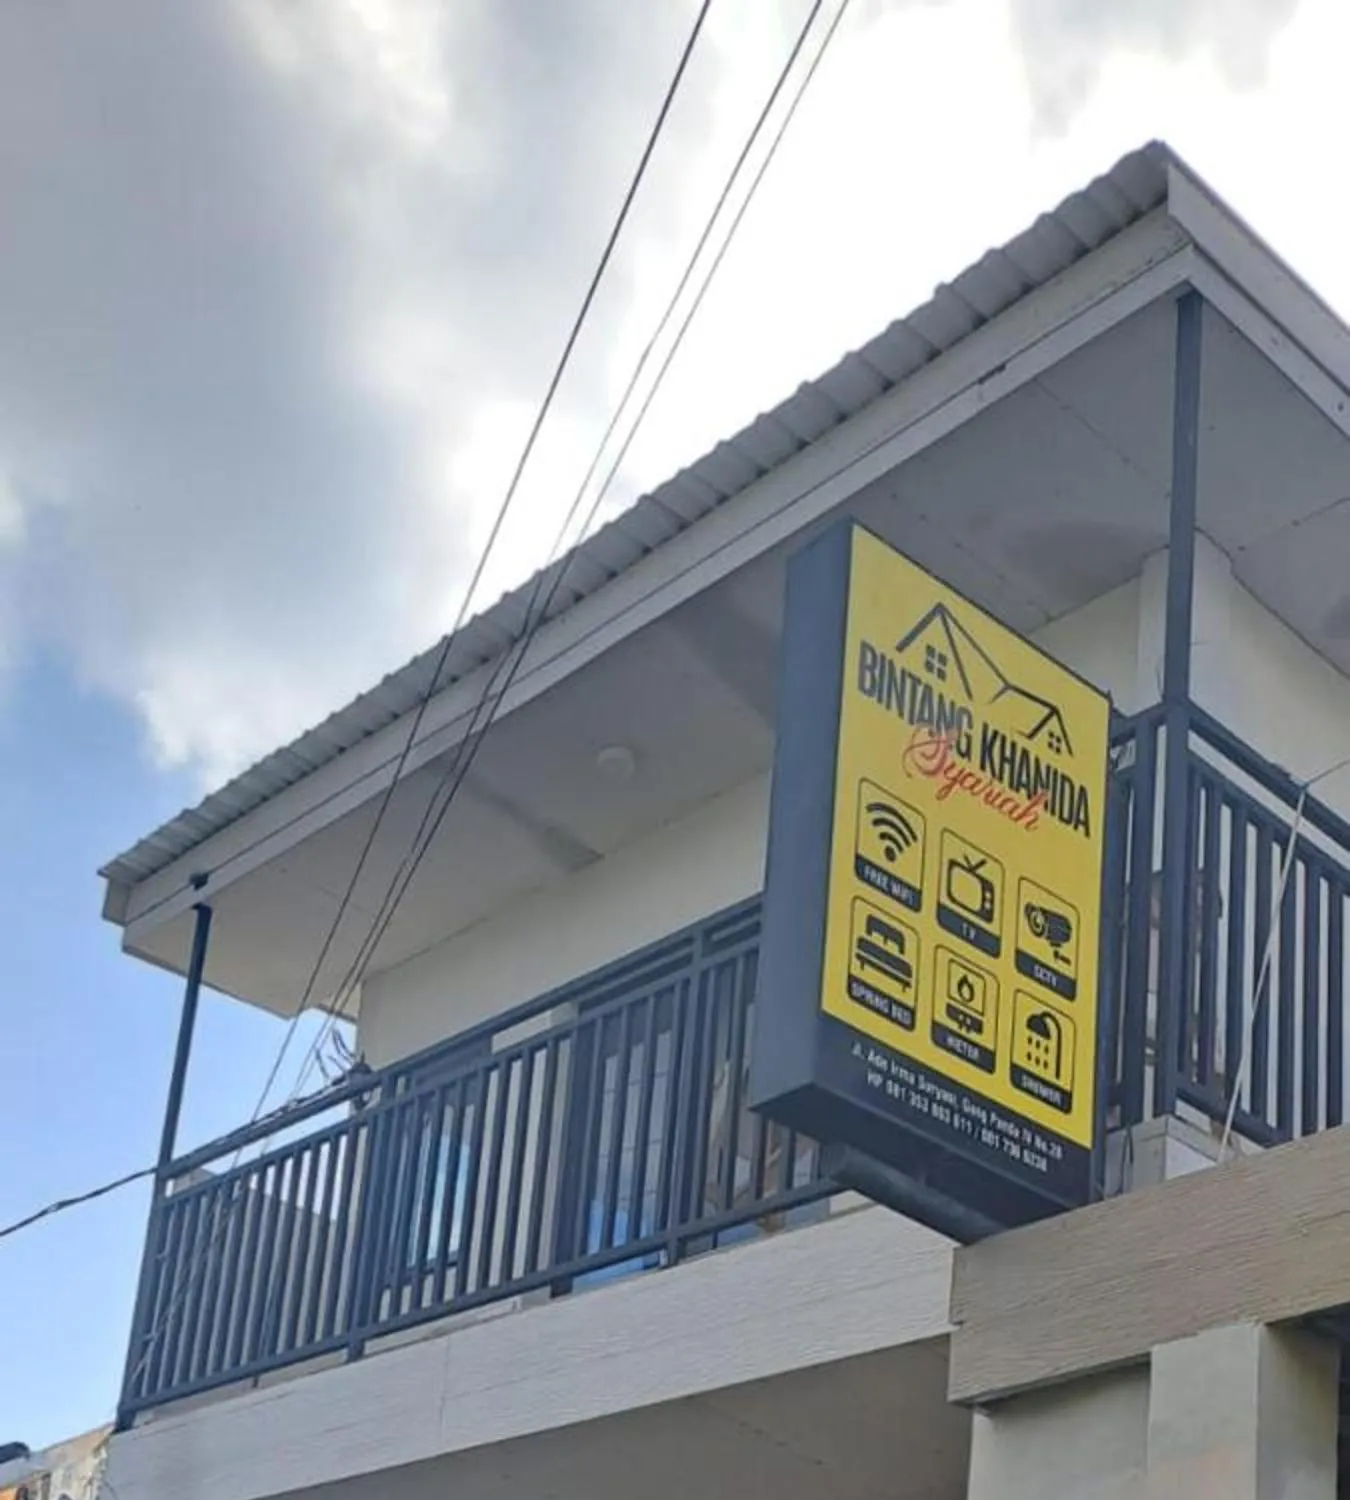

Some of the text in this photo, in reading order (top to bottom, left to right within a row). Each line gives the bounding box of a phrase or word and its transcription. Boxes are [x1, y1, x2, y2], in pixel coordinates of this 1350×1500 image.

[858, 641, 1091, 839] BINTANG KHANIDA
[903, 725, 1046, 832] Syariah
[863, 865, 889, 893] FREE
[962, 921, 977, 940] TV
[1033, 964, 1057, 988] CCTV
[851, 981, 912, 1025] SPRING BED
[1021, 1073, 1061, 1107] SHOWER
